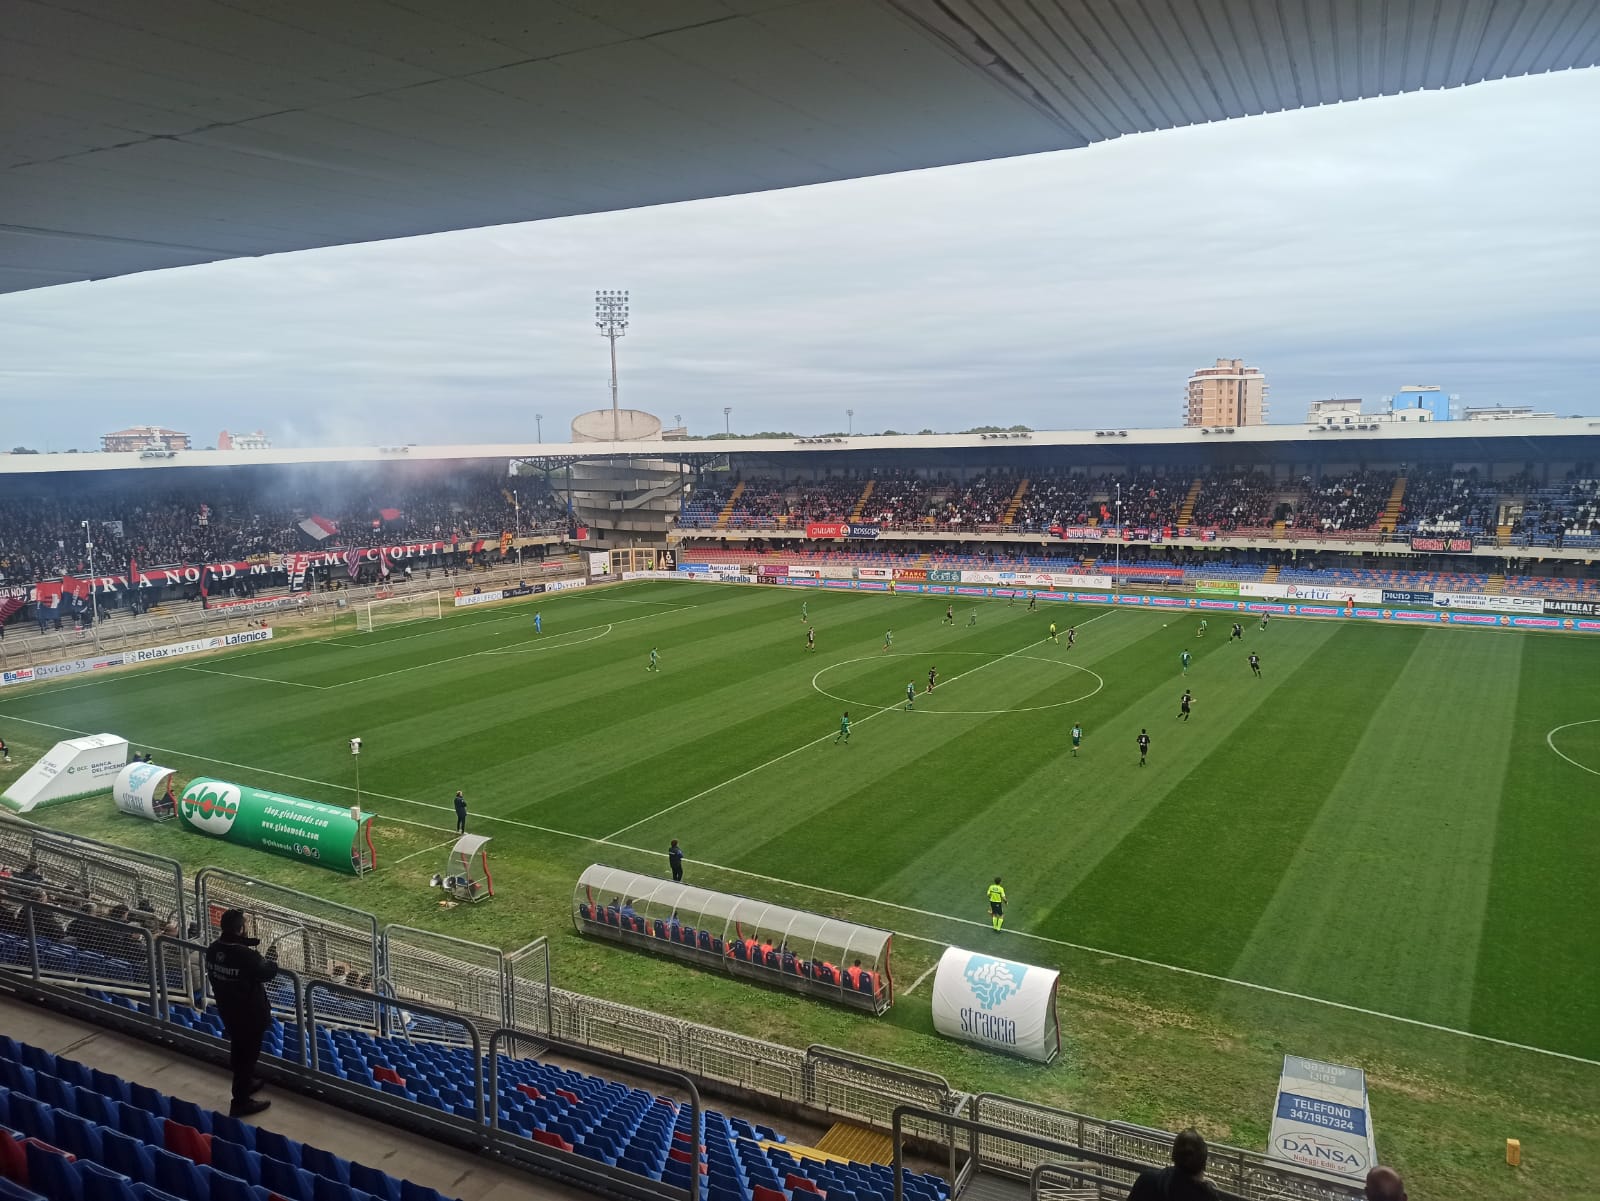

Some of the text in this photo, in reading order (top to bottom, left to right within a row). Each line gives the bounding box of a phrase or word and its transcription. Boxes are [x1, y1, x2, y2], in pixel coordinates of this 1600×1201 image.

[720, 573, 751, 583] Sideralba
[1544, 601, 1594, 612] HEARTBEAT
[138, 648, 169, 660] Relax
[36, 664, 71, 676] Civico
[76, 661, 86, 669] 53
[960, 1007, 1017, 1045] straccia
[1294, 1098, 1351, 1119] TELEFONO
[1283, 1139, 1360, 1167] DANSA
